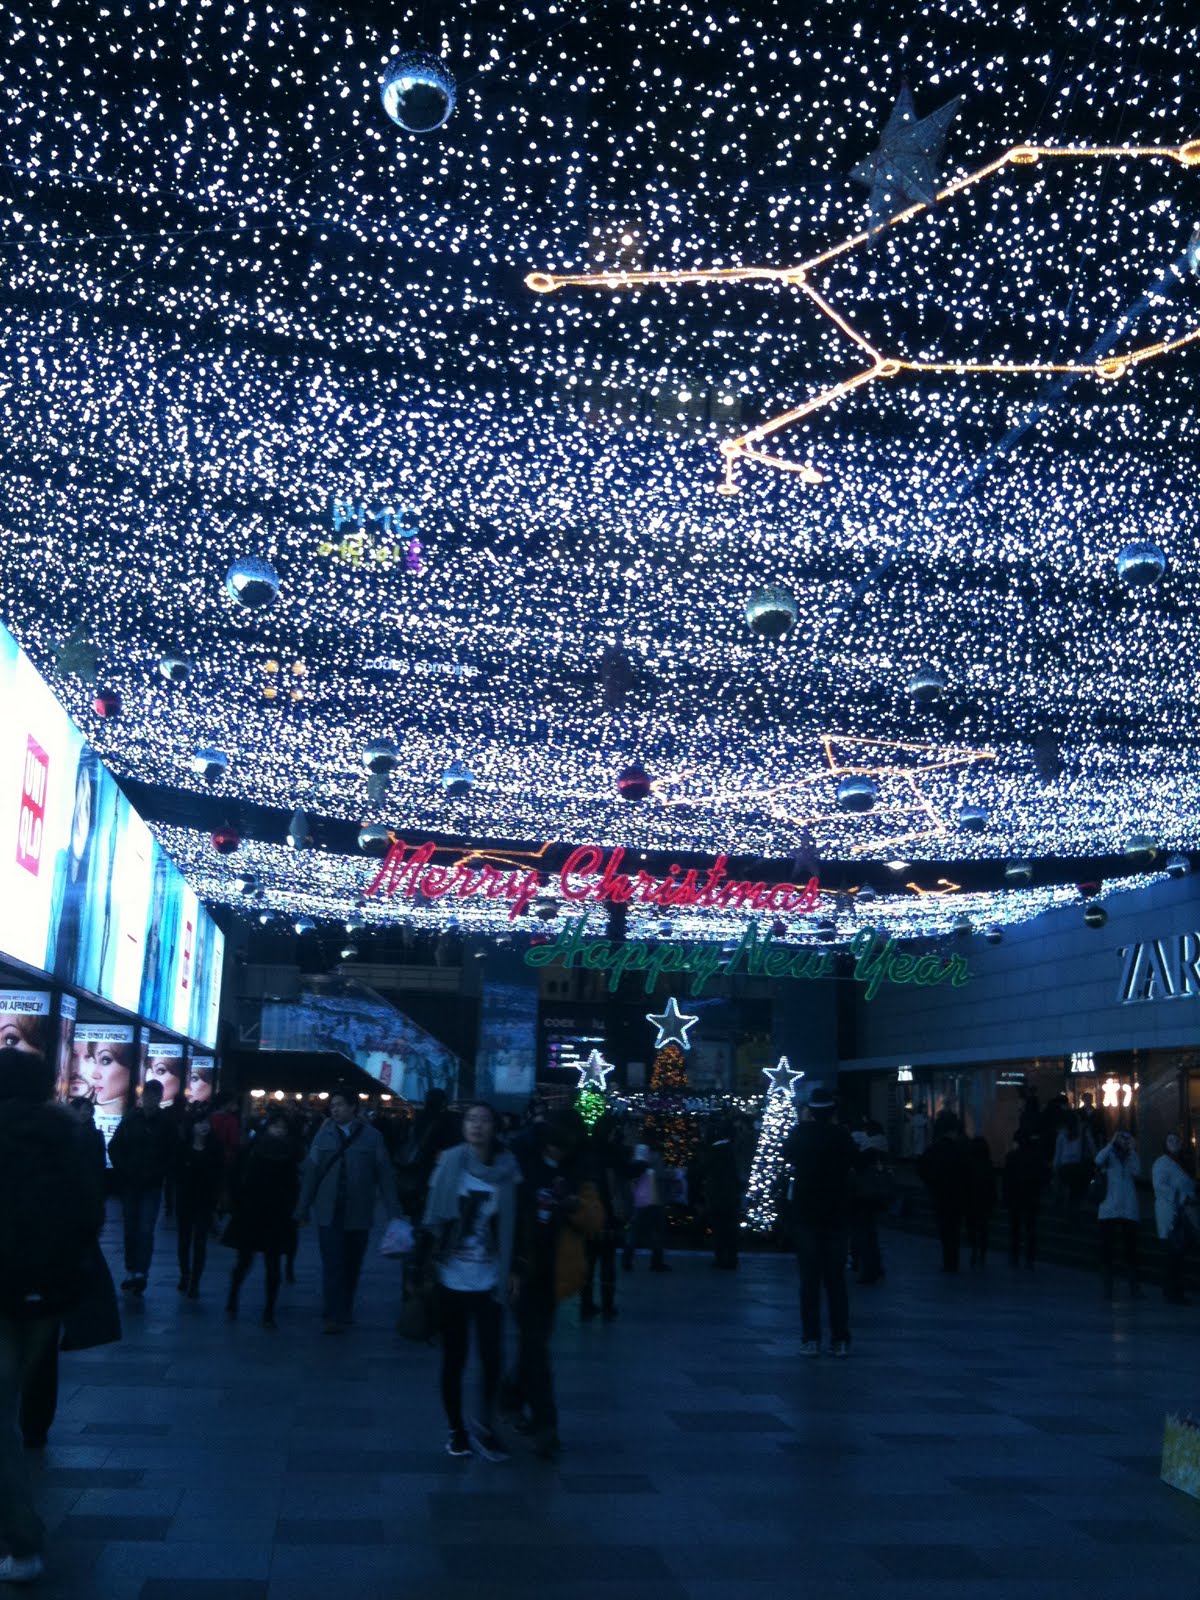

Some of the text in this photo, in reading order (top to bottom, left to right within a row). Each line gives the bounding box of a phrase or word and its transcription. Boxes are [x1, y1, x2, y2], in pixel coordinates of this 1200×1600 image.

[364, 841, 822, 920] Merry Christmas
[523, 912, 970, 1001] Happy New Year
